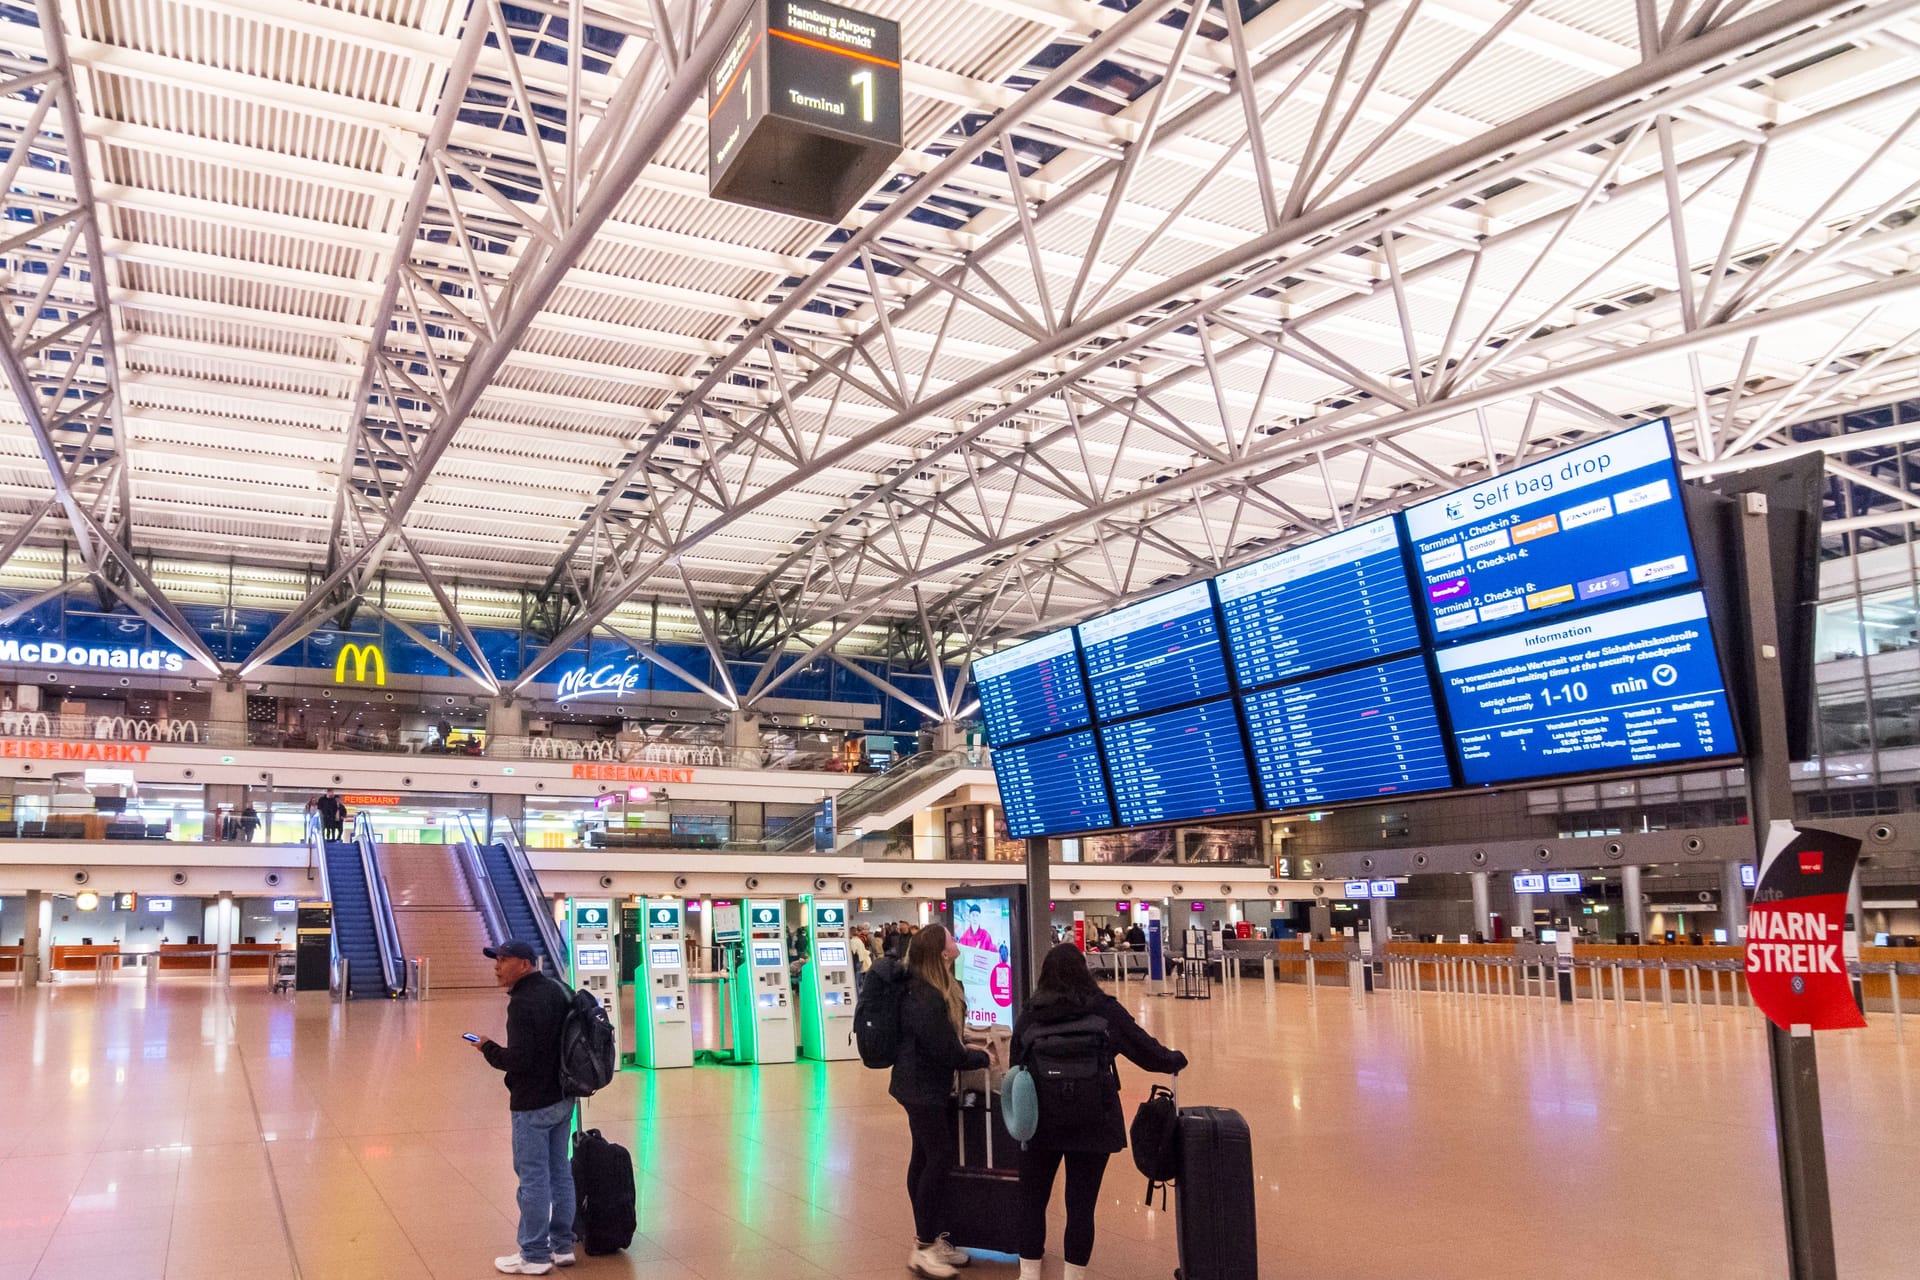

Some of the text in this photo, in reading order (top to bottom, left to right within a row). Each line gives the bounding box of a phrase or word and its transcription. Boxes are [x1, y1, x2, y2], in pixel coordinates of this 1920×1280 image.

[788, 3, 876, 37] Hamburg Airport
[788, 16, 872, 48] Helmut Schmidt
[742, 68, 751, 120] 1
[789, 89, 844, 115] Terminal
[851, 71, 873, 122] 1
[1473, 454, 1611, 510] Self bag drop
[1419, 514, 1521, 553] Terminal 1, Check-in 3:
[1426, 548, 1529, 584] Terminal 1, Check-in 4:
[1433, 598, 1472, 616] Terminal
[1473, 597, 1482, 606] 2,
[1484, 585, 1525, 603] Check-in
[1587, 580, 1609, 593] SAS
[1525, 625, 1592, 647] Information
[0, 640, 183, 671] McDonald's
[1451, 678, 1464, 686] Die
[1527, 656, 1568, 671] Wartezeit
[1569, 653, 1584, 663] vor
[1585, 650, 1600, 660] der
[1601, 630, 1698, 656] Sicherheitskontrolle
[1461, 643, 1692, 694] The estimated waiting time at the security checkpoint
[557, 665, 639, 699] McCafé
[1540, 682, 1588, 706] 1-10
[1611, 677, 1648, 695] min
[1501, 703, 1534, 714] currently
[1506, 693, 1532, 703] derzeit
[0, 739, 151, 762] EISEMARKT
[572, 764, 695, 783] REISEMARKT
[344, 795, 400, 805] REISEMARKT
[1279, 859, 1288, 872] 2
[1749, 911, 1839, 941] WARN-
[1747, 943, 1842, 973] STREIK
[967, 1008, 997, 1023] raine
